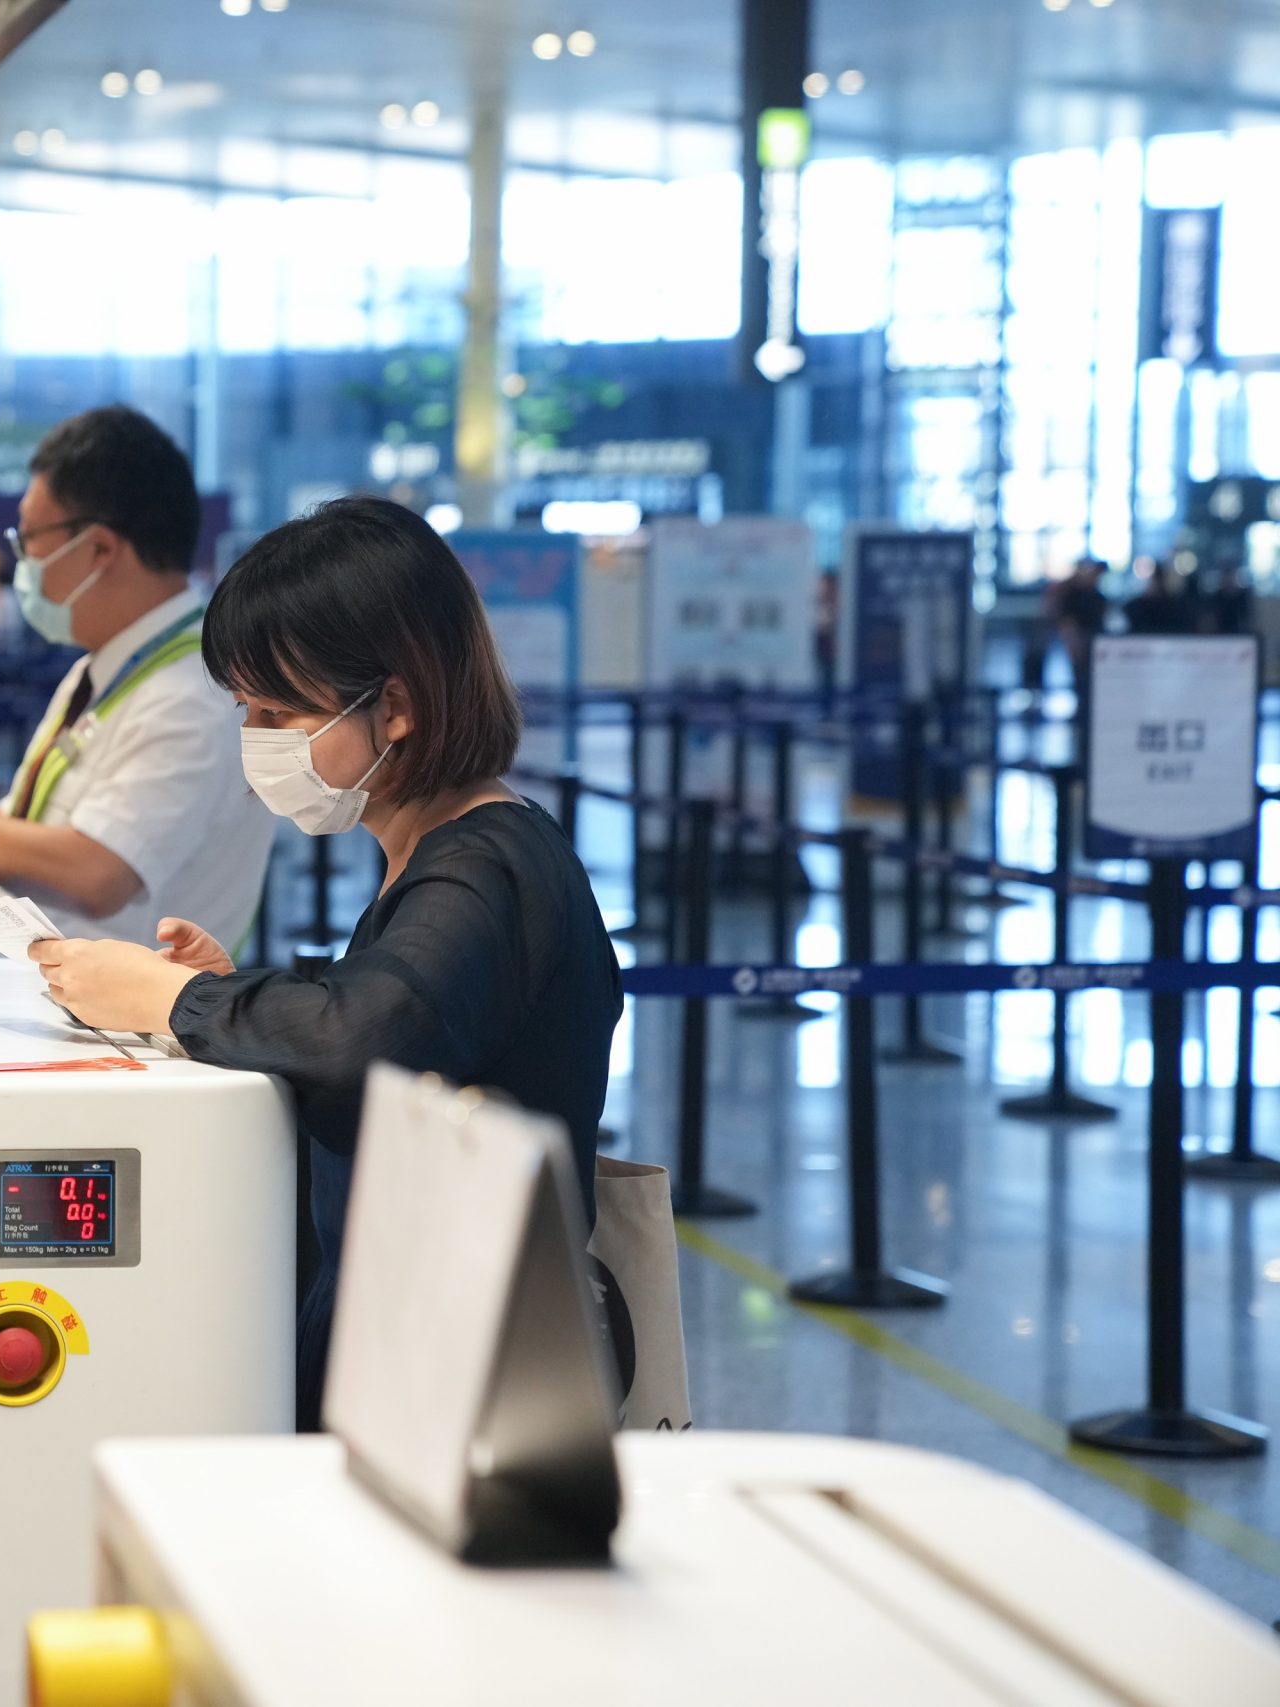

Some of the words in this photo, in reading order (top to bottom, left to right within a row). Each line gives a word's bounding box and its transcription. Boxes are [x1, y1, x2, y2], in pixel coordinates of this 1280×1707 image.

[1137, 719, 1206, 751] 出口
[5, 1164, 33, 1173] ATRAX
[5, 1224, 18, 1232] Bag
[81, 1222, 95, 1239] 0
[25, 1246, 43, 1254] 150kg
[65, 1246, 77, 1254] 2kg
